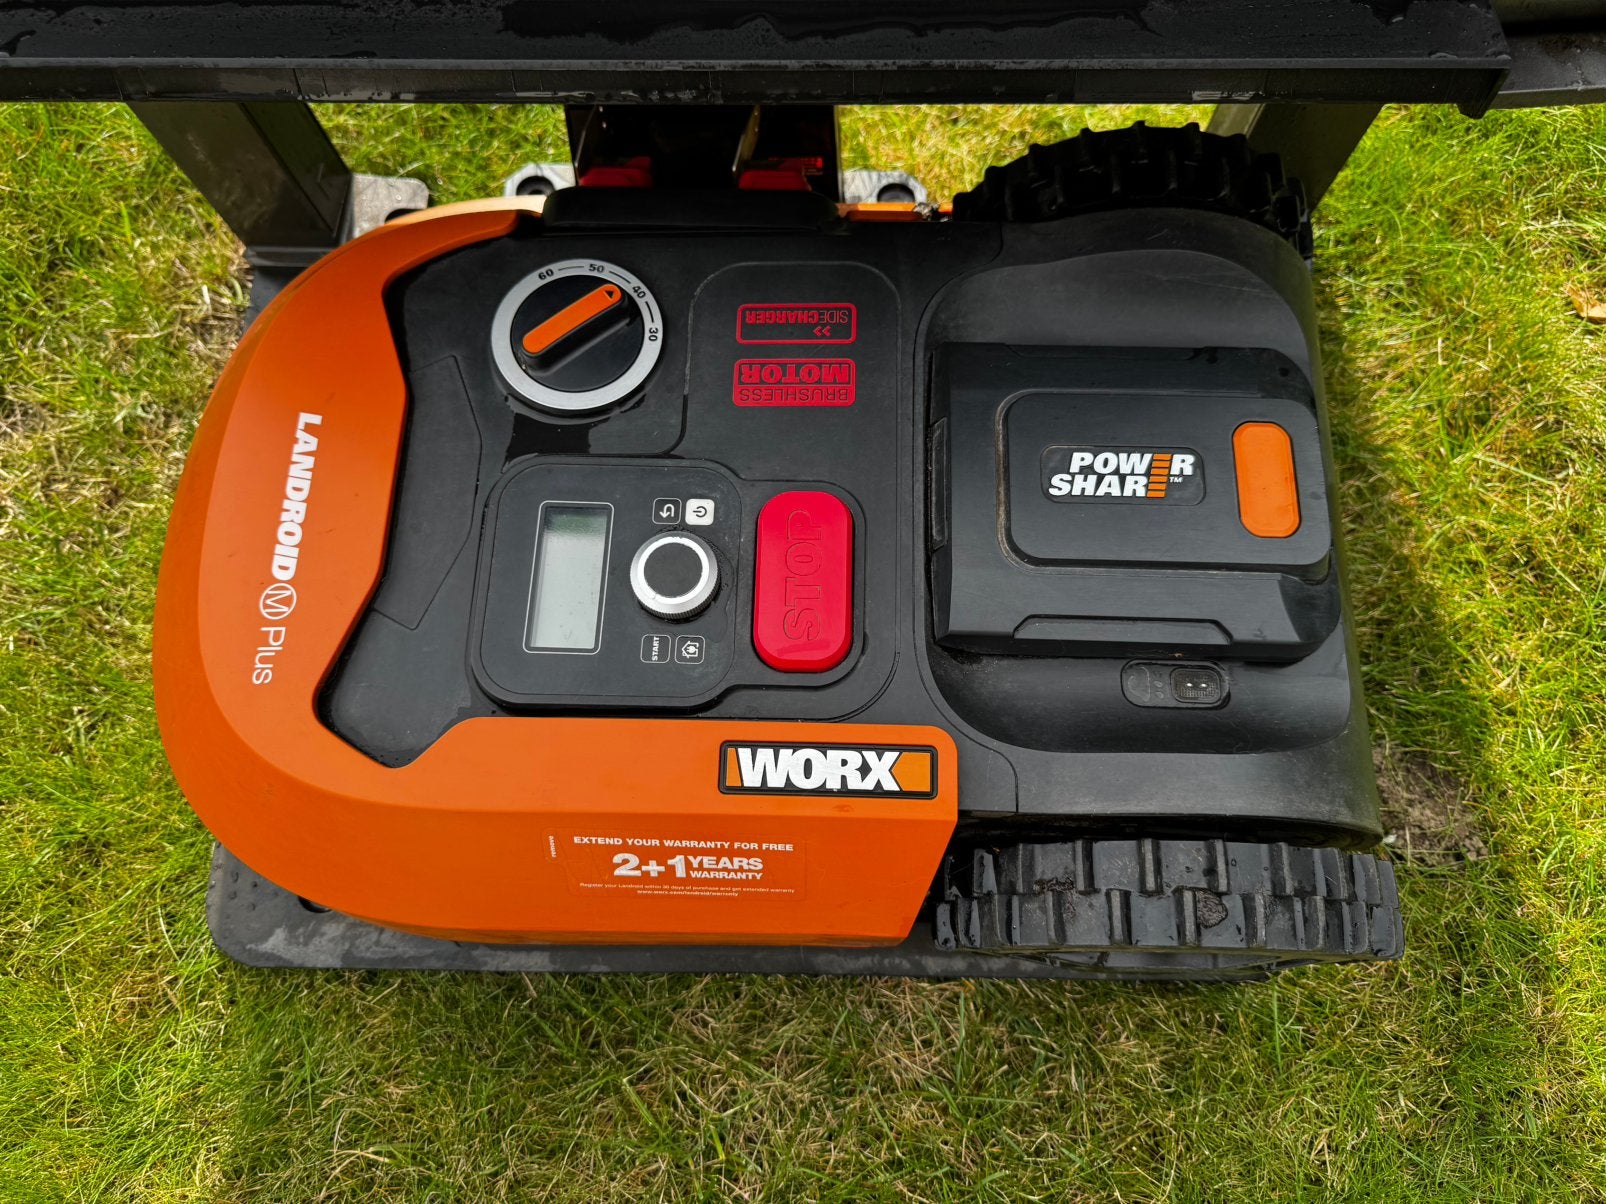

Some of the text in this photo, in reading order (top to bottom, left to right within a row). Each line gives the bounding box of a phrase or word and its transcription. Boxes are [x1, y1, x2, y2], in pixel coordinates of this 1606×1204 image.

[538, 268, 555, 280] 60
[588, 264, 605, 273] 50
[632, 285, 646, 299] 40
[648, 327, 658, 342] 30
[741, 364, 849, 384] MOTOR
[740, 388, 849, 402] BRUSHLESS
[1069, 451, 1195, 476] POWER
[271, 412, 323, 581] LANDROID
[1048, 473, 1168, 498] SHARE
[783, 509, 822, 641] STOP
[252, 626, 286, 684] Plus
[651, 636, 660, 661] START
[737, 748, 901, 791] WORX
[548, 835, 557, 858] remove
[573, 836, 794, 851] EXTEND YOUR WARRANTY FOR FREE
[612, 852, 763, 878] 2+1 YEARS
[690, 870, 763, 880] WARRANTY
